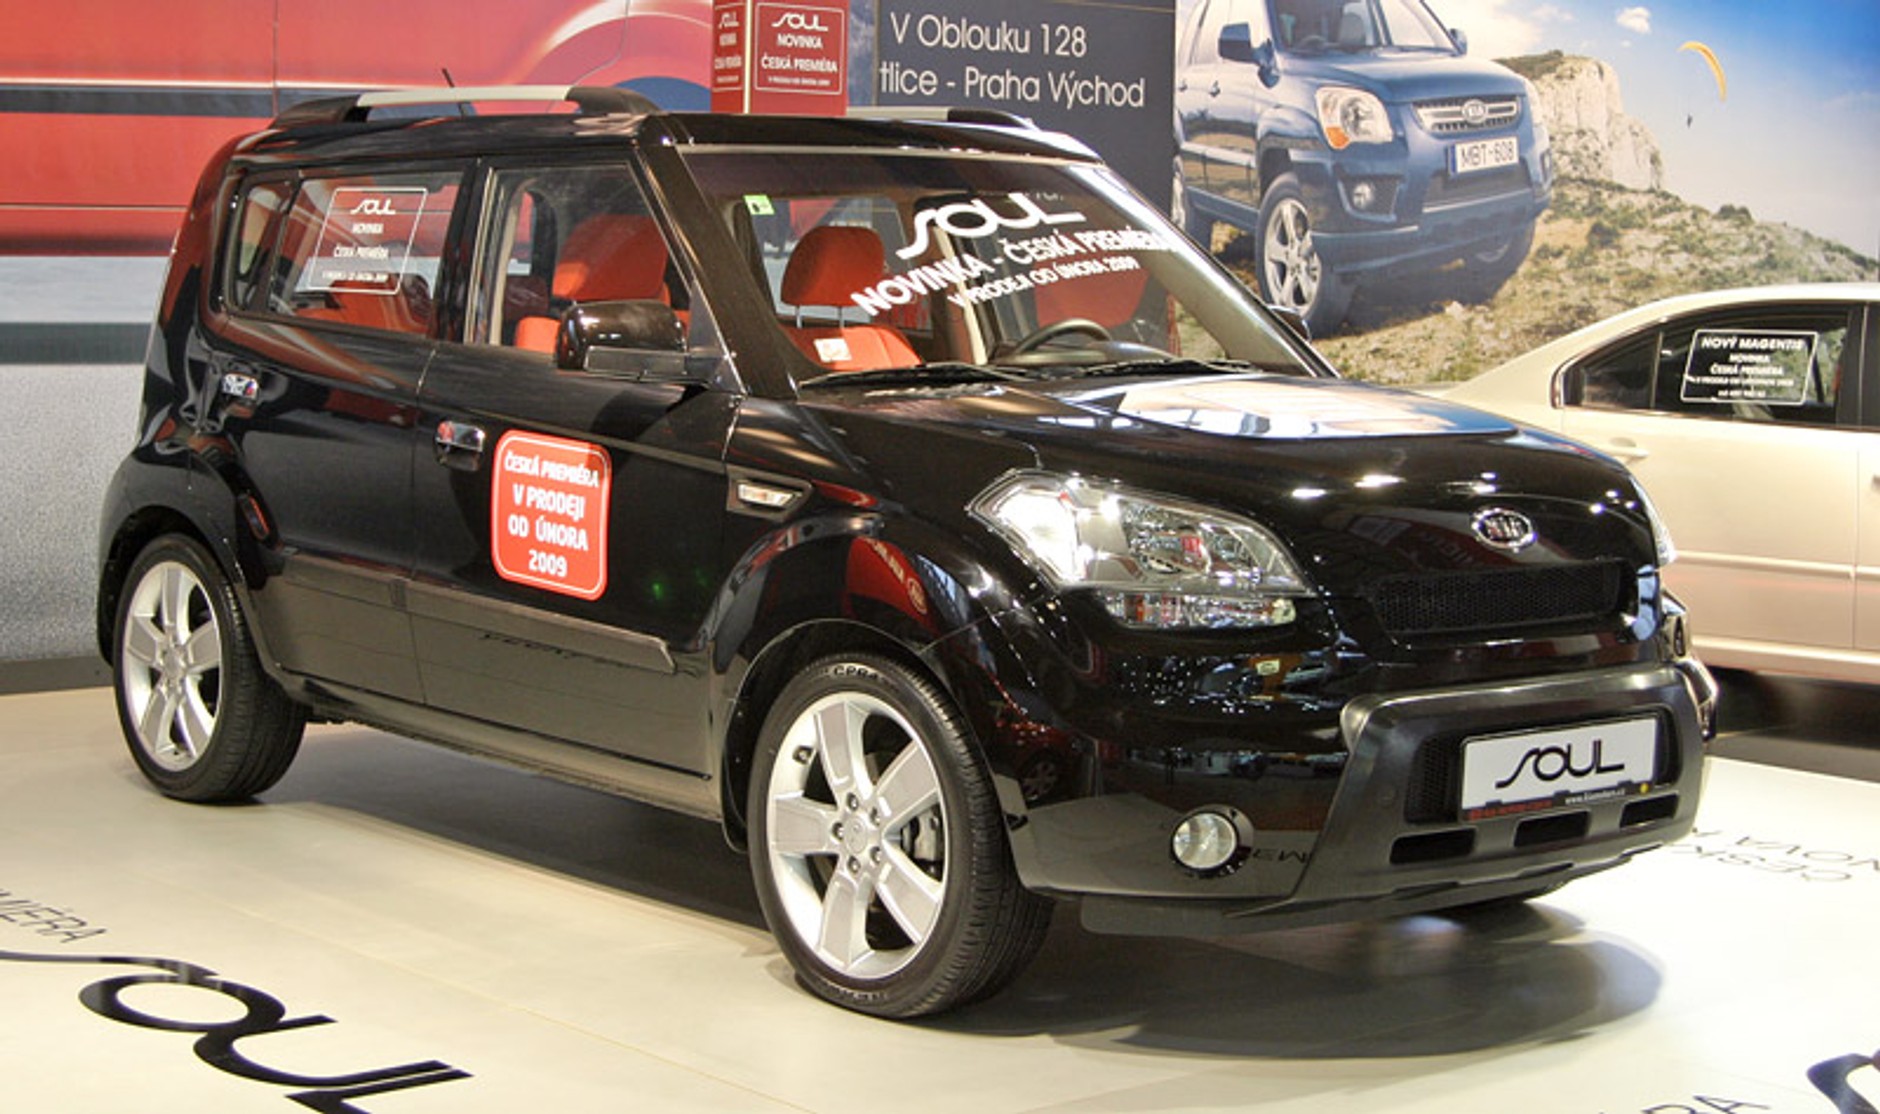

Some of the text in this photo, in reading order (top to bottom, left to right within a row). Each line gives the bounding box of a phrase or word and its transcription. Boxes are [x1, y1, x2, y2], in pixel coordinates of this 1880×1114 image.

[771, 12, 829, 32] SOUL
[777, 32, 823, 49] NOVINKA
[890, 12, 1087, 58] V Oblouku 128
[965, 66, 1041, 101] Praha
[1048, 70, 1146, 110] Východ
[350, 198, 396, 215] SOUL
[896, 192, 1087, 260] SOUL
[850, 254, 996, 317] NOVINKA
[998, 228, 1082, 266] ČESKÁ
[965, 269, 1034, 306] PRODEJI
[1029, 267, 1060, 286] OD
[504, 450, 599, 488] ČESKÁ PREMIÉRA
[513, 484, 586, 522] V PRODEJI
[508, 514, 588, 551] OD ÚNORA
[528, 549, 568, 577] 2009
[1495, 739, 1625, 789] SOUL
